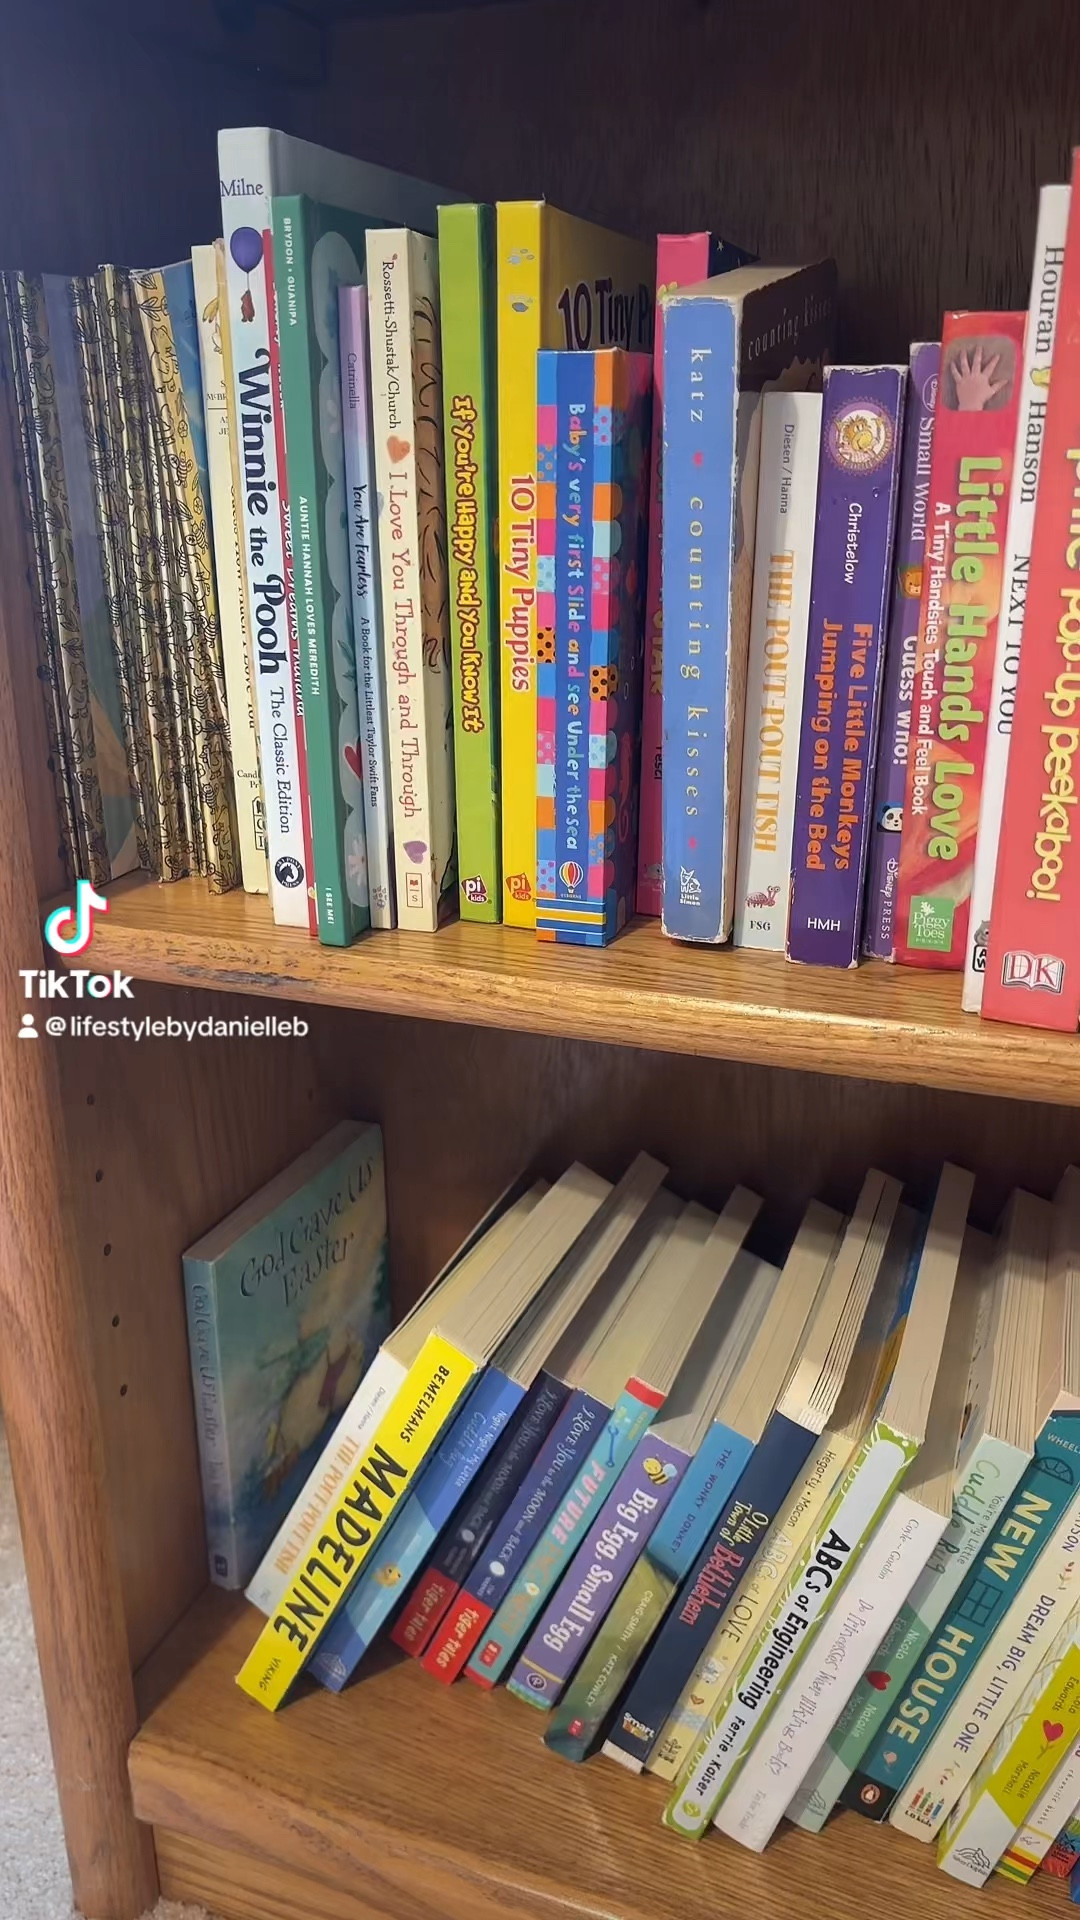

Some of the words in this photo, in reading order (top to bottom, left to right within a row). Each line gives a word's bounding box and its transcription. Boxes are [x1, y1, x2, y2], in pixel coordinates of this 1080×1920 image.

[220, 179, 264, 197] Milne
[283, 217, 294, 265] BRYDON
[287, 275, 297, 326] GUANIPA
[1035, 245, 1065, 353] Houran
[382, 260, 401, 429] Rossetti-Shustak/Church
[347, 353, 360, 409] Catrinella
[691, 348, 712, 422] katz
[451, 395, 477, 422] If
[239, 347, 276, 517] Winnie
[562, 403, 587, 471] Baby's
[781, 424, 795, 465] Diesen
[916, 416, 936, 476] Small
[1020, 400, 1048, 504] Hanson
[451, 424, 478, 498] You're
[352, 484, 367, 512] You
[389, 485, 408, 540] Love
[509, 474, 536, 512] 10
[562, 478, 581, 528] very
[779, 477, 792, 513] Hanna
[911, 481, 930, 541] World
[935, 501, 951, 516] A
[300, 496, 310, 541] AUNTIE
[352, 514, 369, 543] Are
[452, 499, 478, 566] Happy
[951, 456, 1005, 582] Little
[250, 526, 268, 567] the
[505, 517, 536, 581] Tiny
[567, 533, 585, 579] first
[844, 502, 863, 584] Christelow
[927, 520, 950, 567] Tiny
[303, 542, 314, 594] HANNAH
[355, 544, 373, 599] Fearless
[392, 548, 411, 591] You
[457, 567, 482, 607] and
[680, 496, 709, 679] counting
[767, 550, 794, 608] THE
[253, 574, 288, 675] Pooh
[306, 595, 316, 635] LOVES
[361, 616, 369, 627] A
[925, 566, 946, 645] Handsies
[361, 628, 370, 657] Book
[392, 598, 417, 686] Through
[457, 607, 482, 650] You
[504, 587, 536, 692] Puppies
[308, 637, 320, 695] MEREDITH
[362, 658, 371, 668] for
[567, 638, 585, 678] and
[850, 623, 873, 679] Five
[364, 669, 372, 684] the
[811, 618, 843, 733] Jumping
[919, 648, 939, 703] Touch
[938, 604, 989, 742] Hands
[270, 686, 284, 719] The
[365, 685, 374, 727] Littlest
[398, 694, 418, 731] and
[464, 708, 485, 733] It
[757, 619, 791, 783] POUT-POUT
[844, 686, 868, 752] Little
[917, 704, 935, 735] and
[272, 724, 288, 776] Classic
[366, 729, 375, 759] Taylor
[566, 720, 585, 784] Under
[685, 706, 709, 816] kisses
[813, 738, 830, 770] on
[916, 738, 933, 773] Feel
[368, 760, 376, 784] Swift
[399, 737, 422, 818] Through
[277, 779, 290, 833] Edition
[566, 785, 582, 817] the
[809, 776, 831, 818] the
[831, 758, 862, 870] Monkeys
[911, 773, 929, 816] Book
[928, 761, 975, 861] Love
[1026, 724, 1080, 902] peekaboo!
[753, 790, 780, 852] FISH
[806, 824, 828, 870] Bed
[465, 876, 481, 895] pi
[511, 874, 526, 893] pi
[749, 919, 771, 932] FSG
[807, 917, 841, 932] HMH
[913, 911, 950, 930] Piggy
[914, 922, 946, 939] Toes
[1010, 953, 1057, 987] DK
[400, 1364, 451, 1444] BEMELMANS
[565, 1413, 593, 1446] LOVE
[715, 1448, 733, 1470] THE
[804, 1450, 837, 1489] Hegarty
[523, 1488, 546, 1524] MOON
[551, 1459, 607, 1546] FUTURE
[616, 1487, 659, 1525] Big
[695, 1474, 719, 1509] WONKY
[787, 1496, 812, 1528] Macon
[951, 1458, 1000, 1530] Cuddle
[982, 1495, 1005, 1521] You're
[671, 1513, 696, 1554] DONKEY
[726, 1501, 753, 1527] Town
[900, 1518, 920, 1541] Coyle
[973, 1524, 988, 1541] My
[273, 1443, 409, 1654] MADELINE
[499, 1530, 521, 1562] BACK
[593, 1521, 639, 1562] Egg,
[719, 1527, 736, 1547] of
[957, 1538, 980, 1565] Little
[984, 1490, 1053, 1582] NEW
[805, 1528, 851, 1594] ABCs
[878, 1551, 902, 1580] Gordon
[567, 1562, 614, 1622] Small
[635, 1589, 655, 1617] CRAIG
[679, 1541, 745, 1625] Bethlehem
[794, 1593, 810, 1613] of
[453, 1606, 480, 1639] tiger
[542, 1617, 586, 1653] Egg
[620, 1617, 640, 1643] SMITH
[720, 1594, 760, 1644] LOVE
[1016, 1594, 1056, 1646] DREAM
[436, 1637, 463, 1668] tales
[737, 1612, 809, 1710] Engineering
[824, 1611, 868, 1671] Princesses
[996, 1645, 1026, 1671] BIG,
[258, 1656, 282, 1692] VIKING
[603, 1653, 619, 1675] KATZ
[887, 1624, 975, 1744] HOUSE
[586, 1672, 608, 1708] COWLEY
[972, 1676, 1008, 1721] LITTLE
[719, 1715, 746, 1753] Ferrie
[953, 1722, 980, 1753] ONE
[695, 1759, 723, 1797] Kaiser
